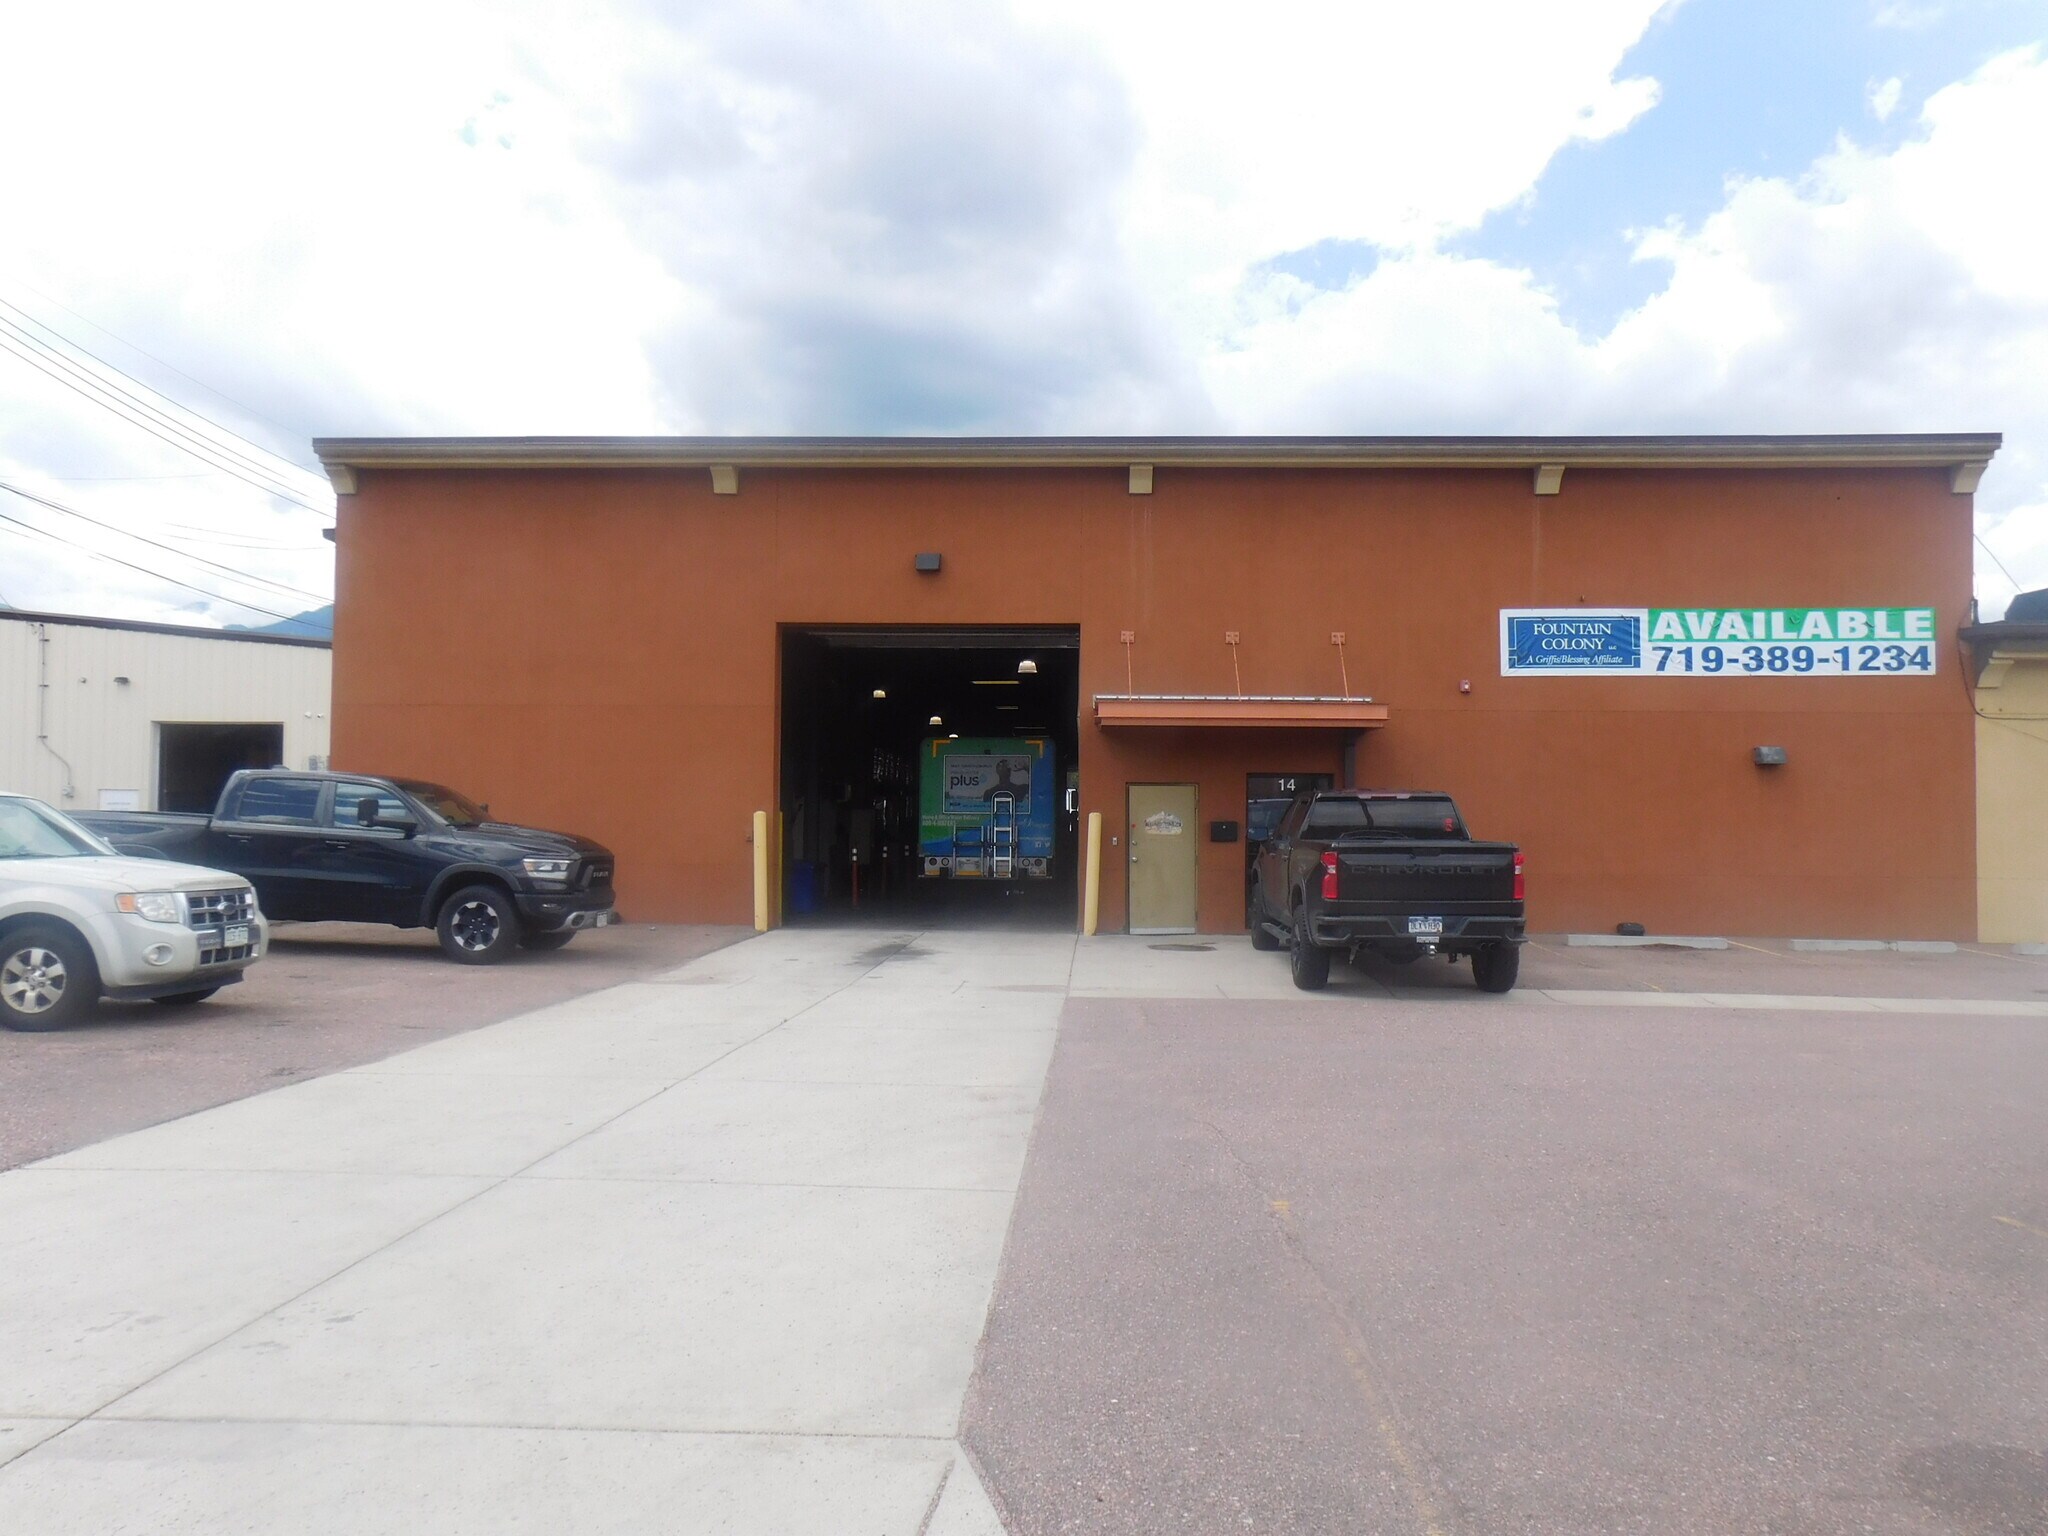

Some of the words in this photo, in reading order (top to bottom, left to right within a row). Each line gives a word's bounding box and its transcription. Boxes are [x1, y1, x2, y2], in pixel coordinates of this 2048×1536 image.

[1533, 623, 1612, 635] FOUNTAIN
[1651, 610, 1933, 640] AVAILABLE
[1541, 638, 1605, 650] COLONY
[1526, 655, 1533, 664] A
[1592, 655, 1623, 665] Affiliate
[1651, 645, 1932, 672] 719-389-1234
[950, 775, 979, 789] plus
[1278, 778, 1296, 791] 14
